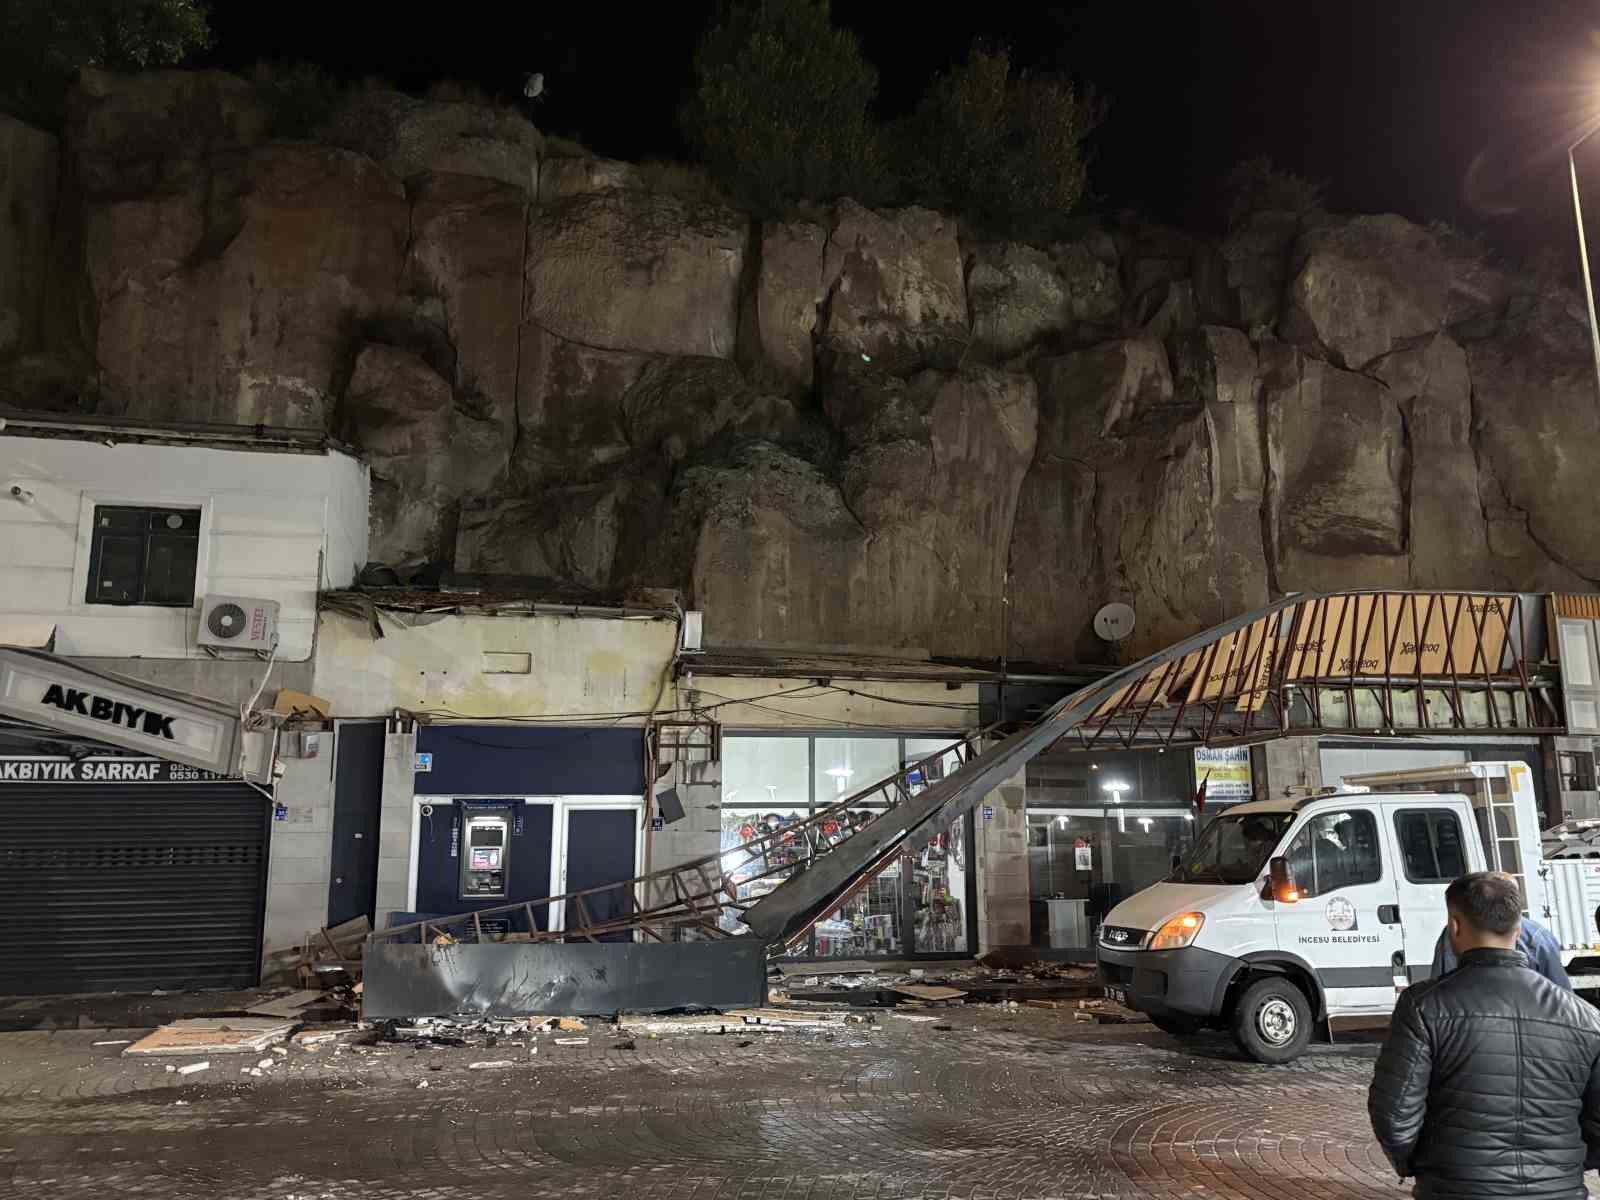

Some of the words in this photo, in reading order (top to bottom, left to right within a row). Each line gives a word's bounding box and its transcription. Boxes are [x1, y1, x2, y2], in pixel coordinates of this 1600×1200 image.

[41, 683, 176, 740] AKBIYIK
[81, 763, 160, 779] SARRAF
[170, 772, 199, 780] 0530
